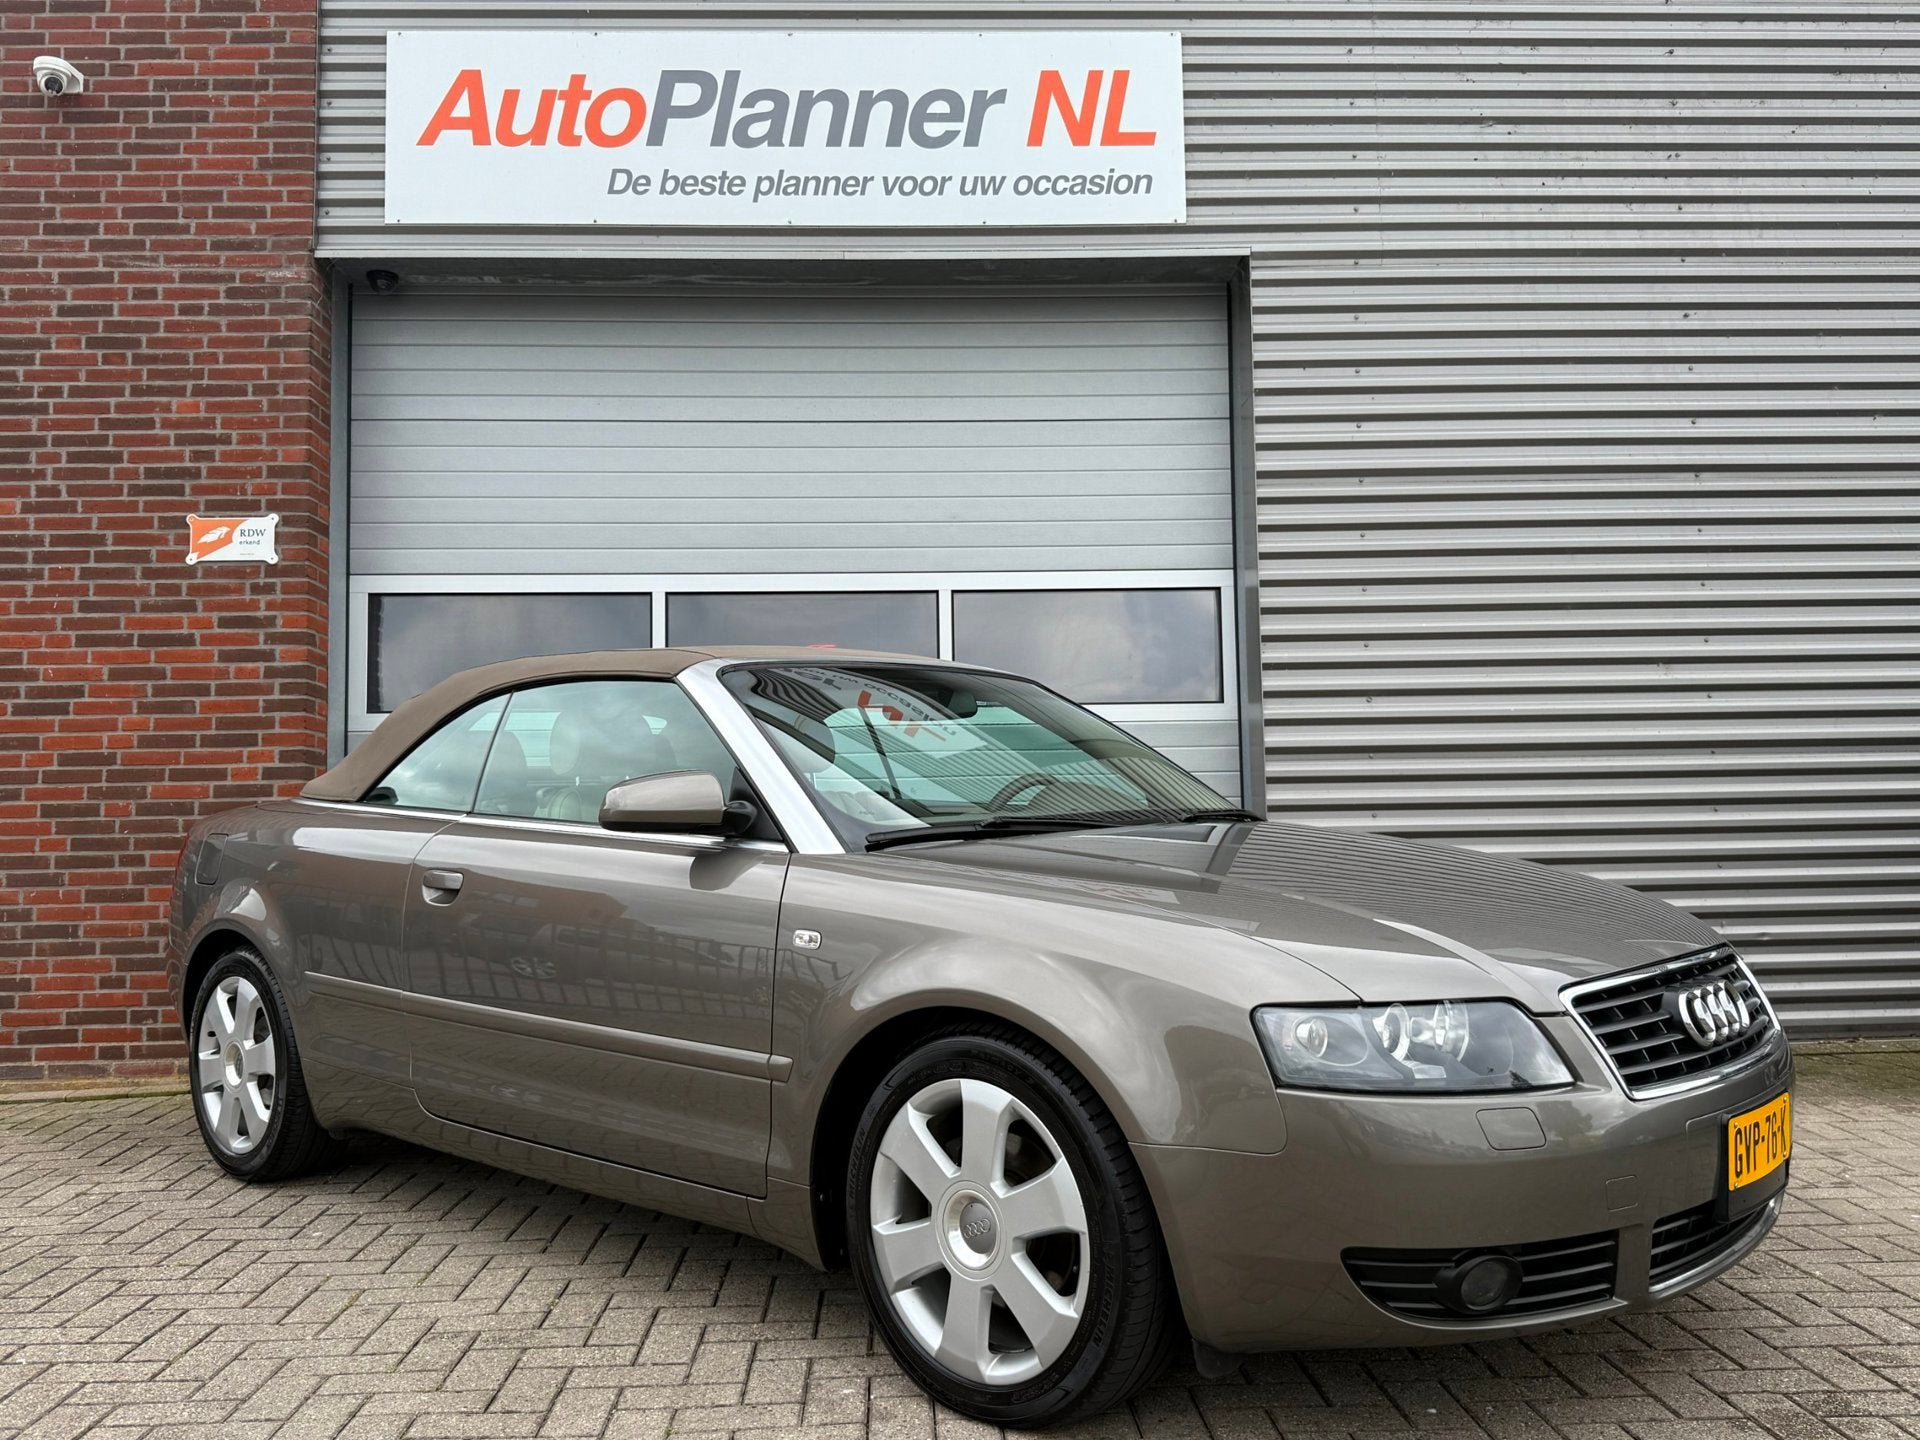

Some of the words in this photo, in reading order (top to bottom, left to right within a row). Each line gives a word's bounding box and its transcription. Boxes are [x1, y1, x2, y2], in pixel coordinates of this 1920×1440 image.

[416, 69, 1007, 149] AutoPlanner
[1026, 69, 1157, 147] NL
[607, 168, 651, 195] De
[659, 168, 746, 196] beste
[752, 169, 874, 203] planner
[882, 174, 952, 197] voor
[959, 174, 1006, 197] uw
[1013, 168, 1153, 197] occasion
[240, 528, 267, 538] RDW
[848, 1128, 866, 1200] MICHELIN
[1734, 1104, 1787, 1179] GVP-76-K
